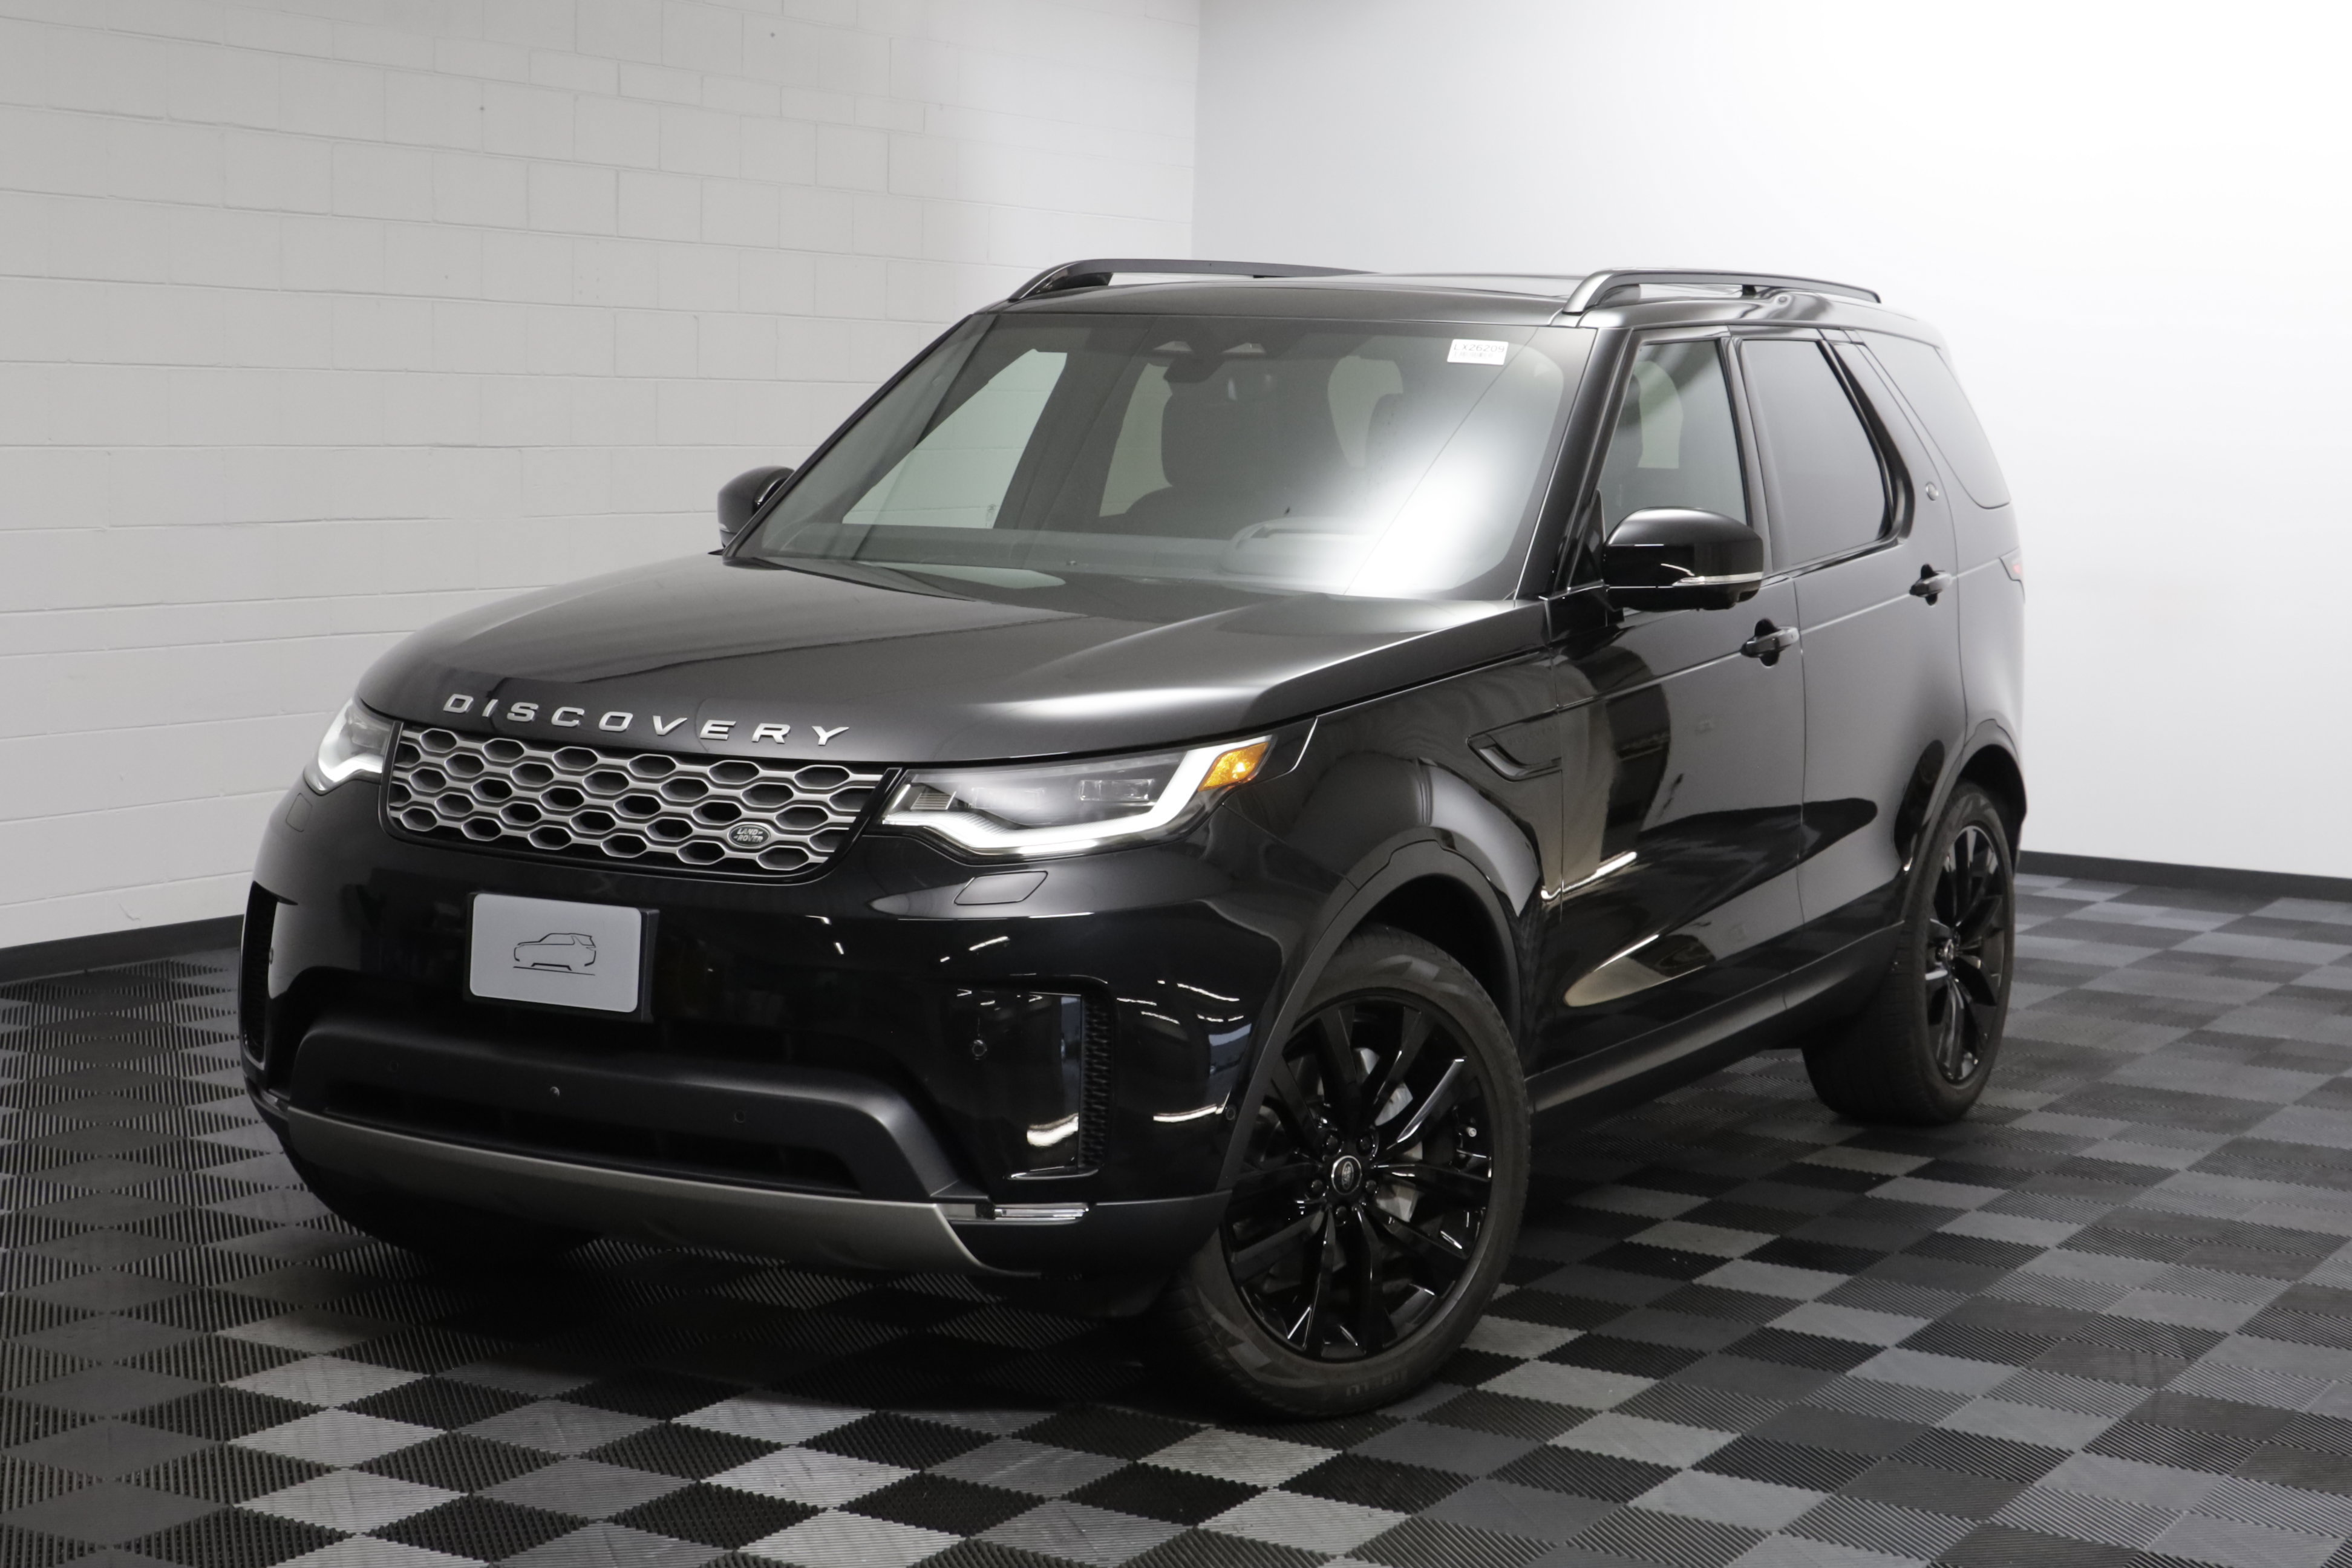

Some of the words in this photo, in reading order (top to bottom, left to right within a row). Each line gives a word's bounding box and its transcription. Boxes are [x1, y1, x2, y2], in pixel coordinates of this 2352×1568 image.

[1454, 344, 1505, 353] LX26209
[443, 693, 849, 746] DISCOVERY
[737, 834, 763, 843] ROVER
